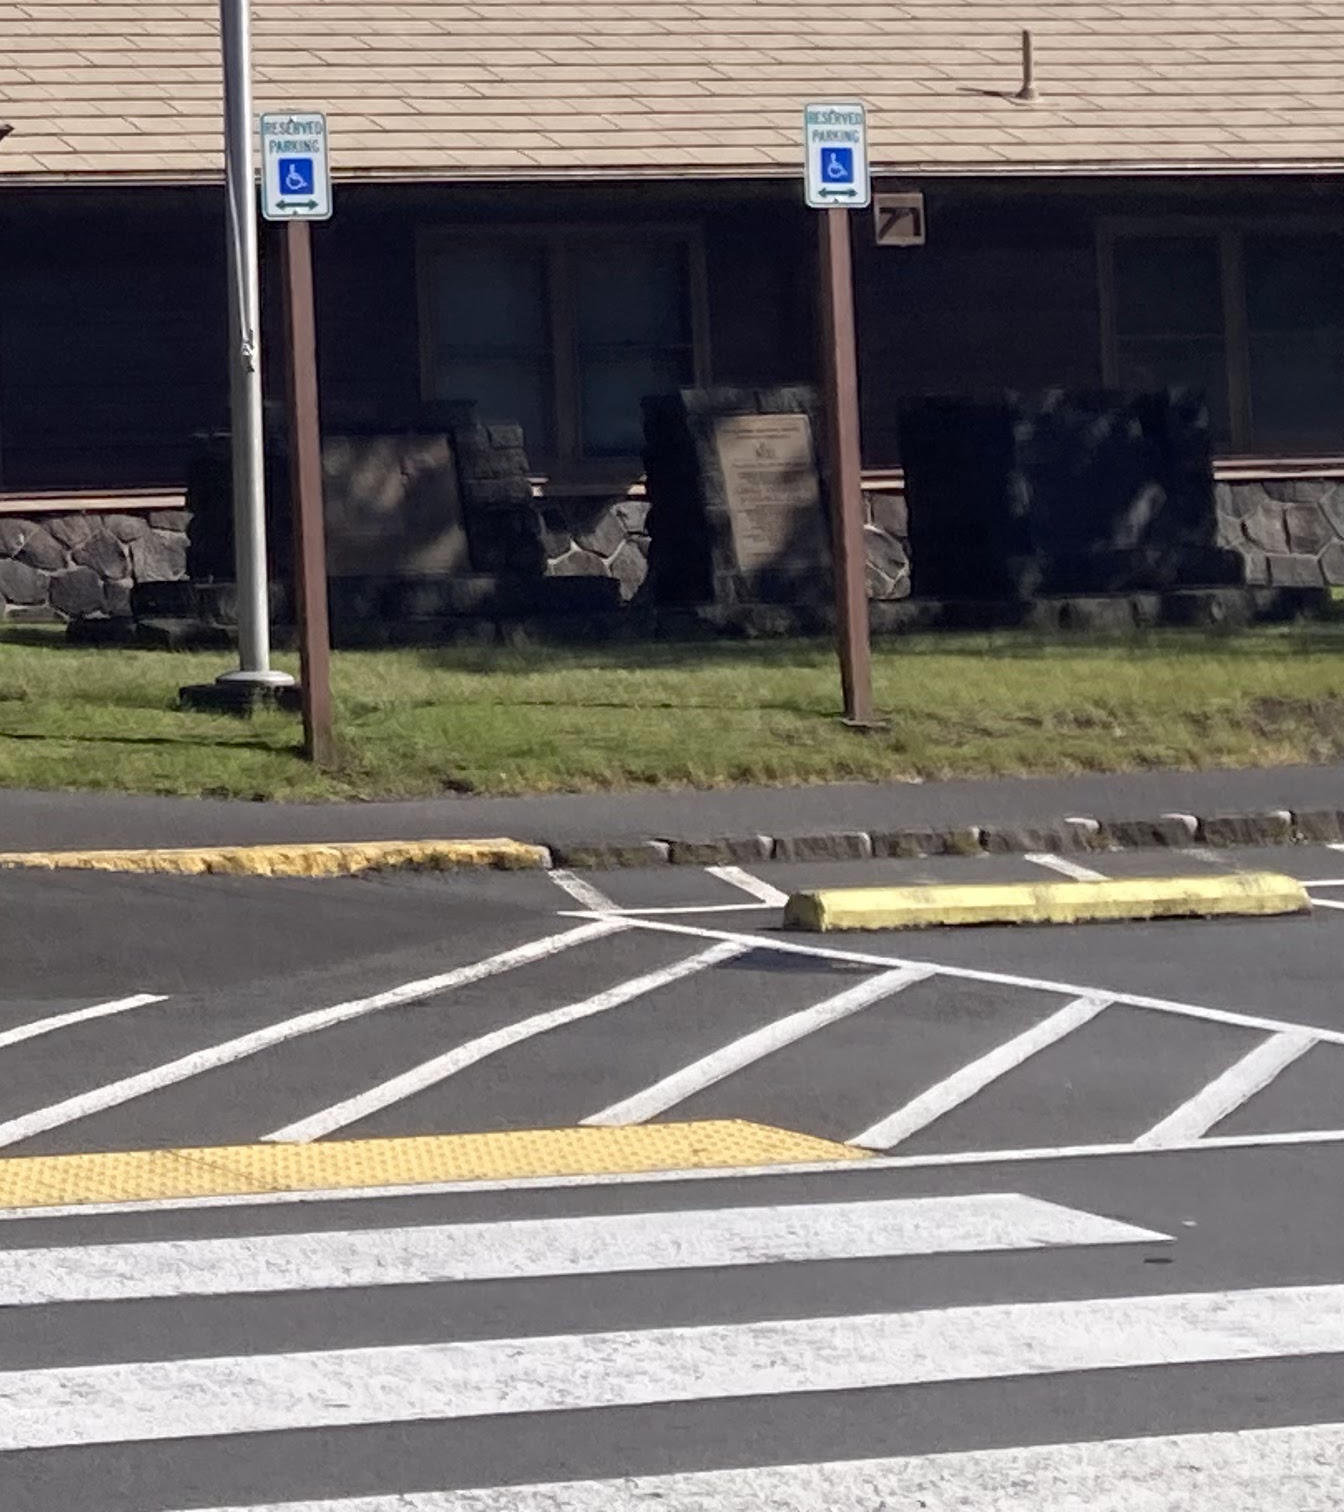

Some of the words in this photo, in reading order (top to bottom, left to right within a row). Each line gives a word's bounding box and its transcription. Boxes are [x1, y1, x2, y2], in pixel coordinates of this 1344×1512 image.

[808, 111, 863, 125] RESERVED
[812, 129, 860, 143] PARKING
[269, 139, 320, 154] PARKING
